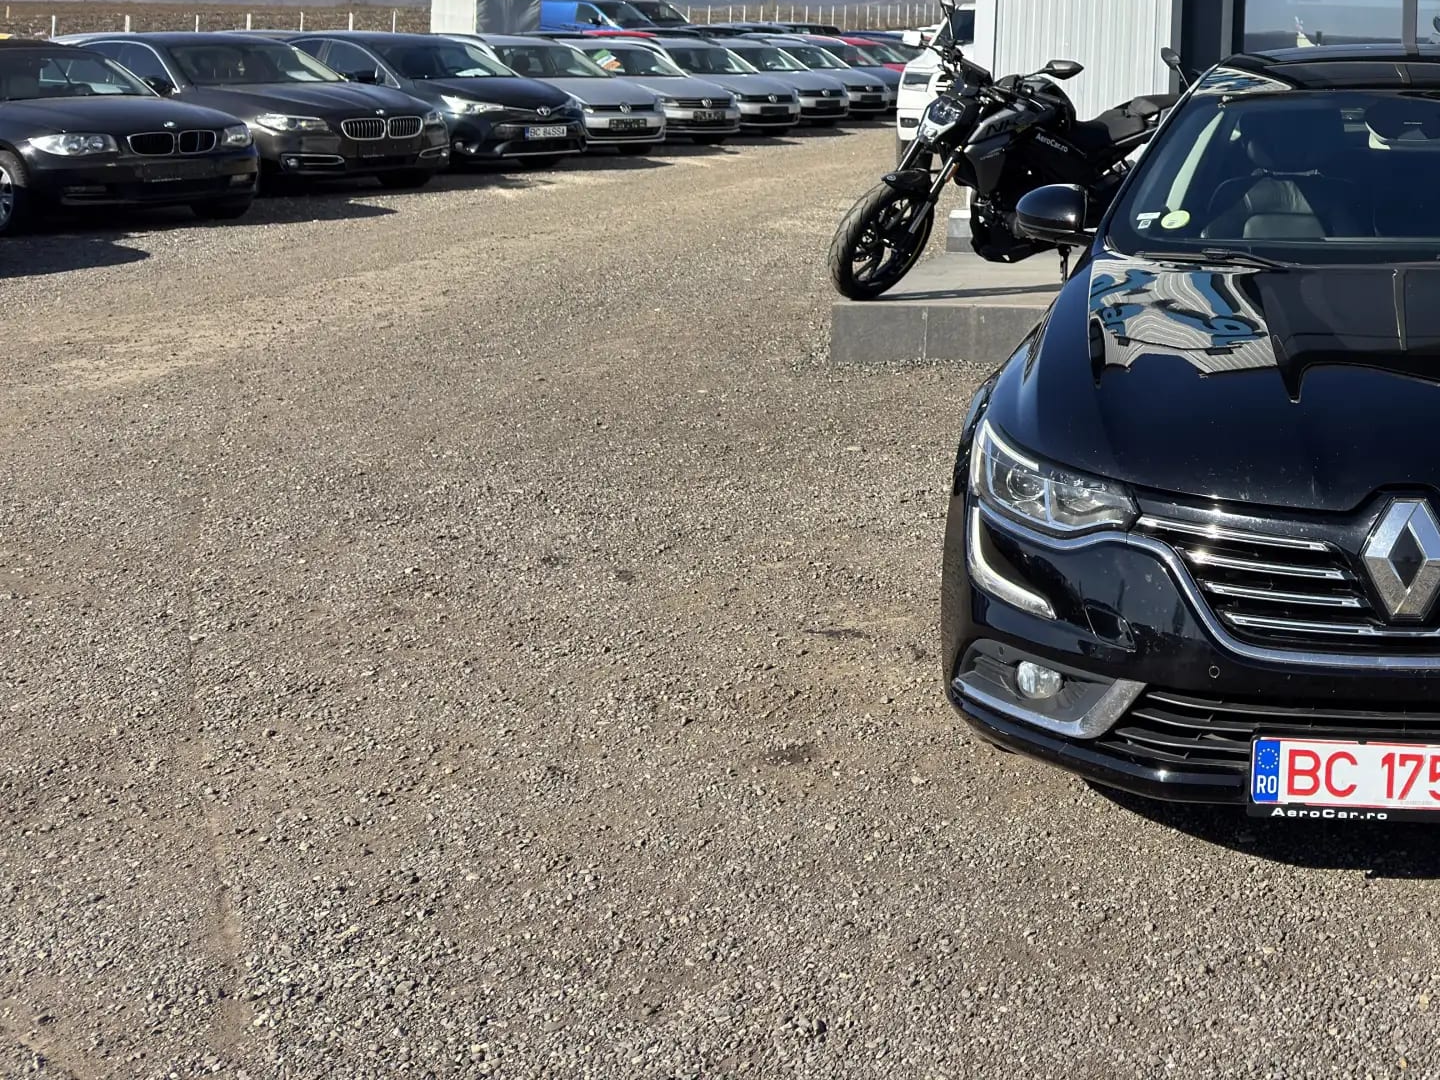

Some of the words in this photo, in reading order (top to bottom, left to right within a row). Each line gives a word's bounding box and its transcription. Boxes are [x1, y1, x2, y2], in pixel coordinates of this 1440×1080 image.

[1035, 132, 1069, 153] AeroCar.ro
[1286, 748, 1358, 797] BC
[1256, 774, 1278, 795] RO
[1270, 806, 1389, 821] AeroCar.ro
